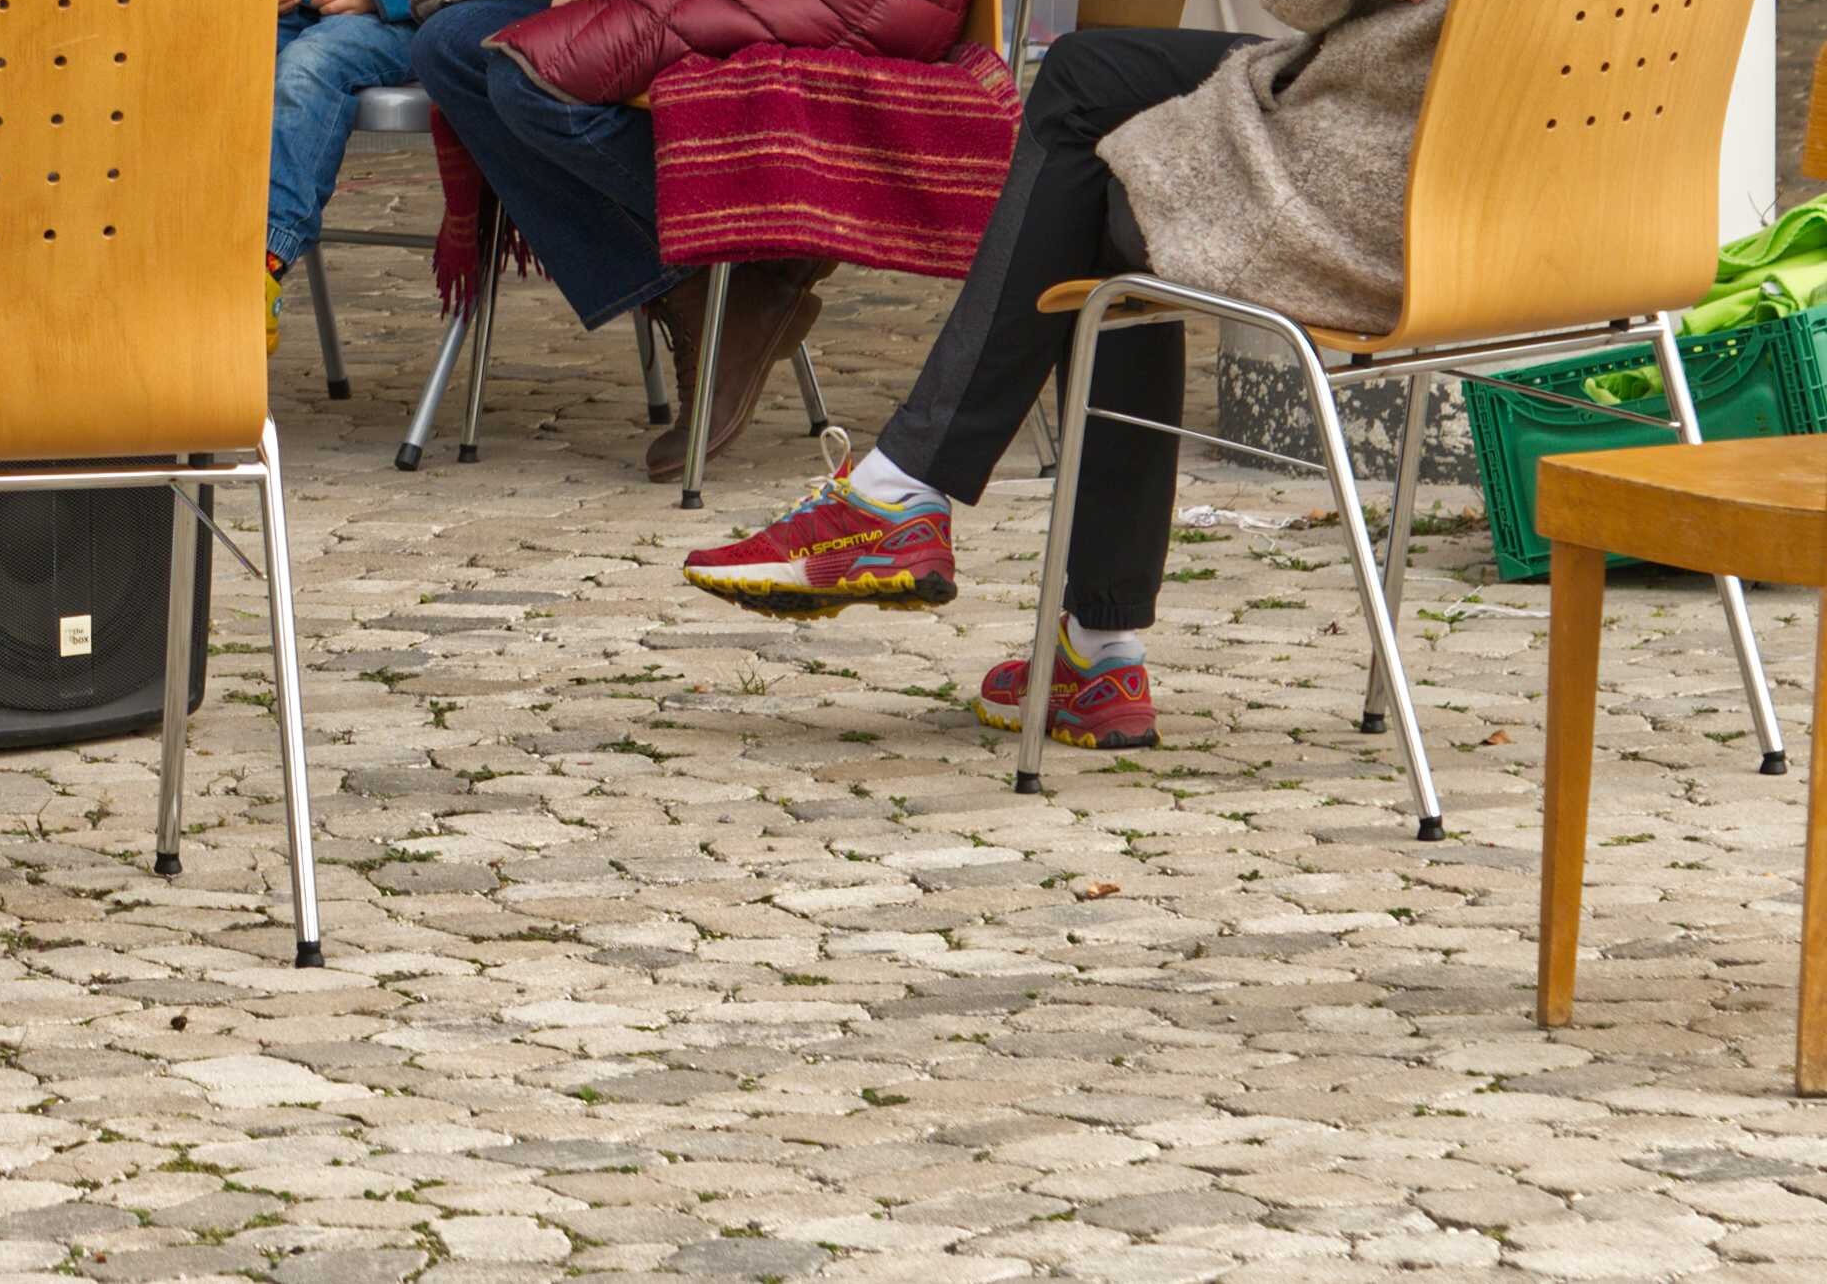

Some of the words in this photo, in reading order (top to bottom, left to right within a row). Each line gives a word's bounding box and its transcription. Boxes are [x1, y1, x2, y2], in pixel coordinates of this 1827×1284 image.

[789, 544, 811, 562] LA
[811, 528, 884, 556] SPORTIVA
[72, 634, 89, 647] box
